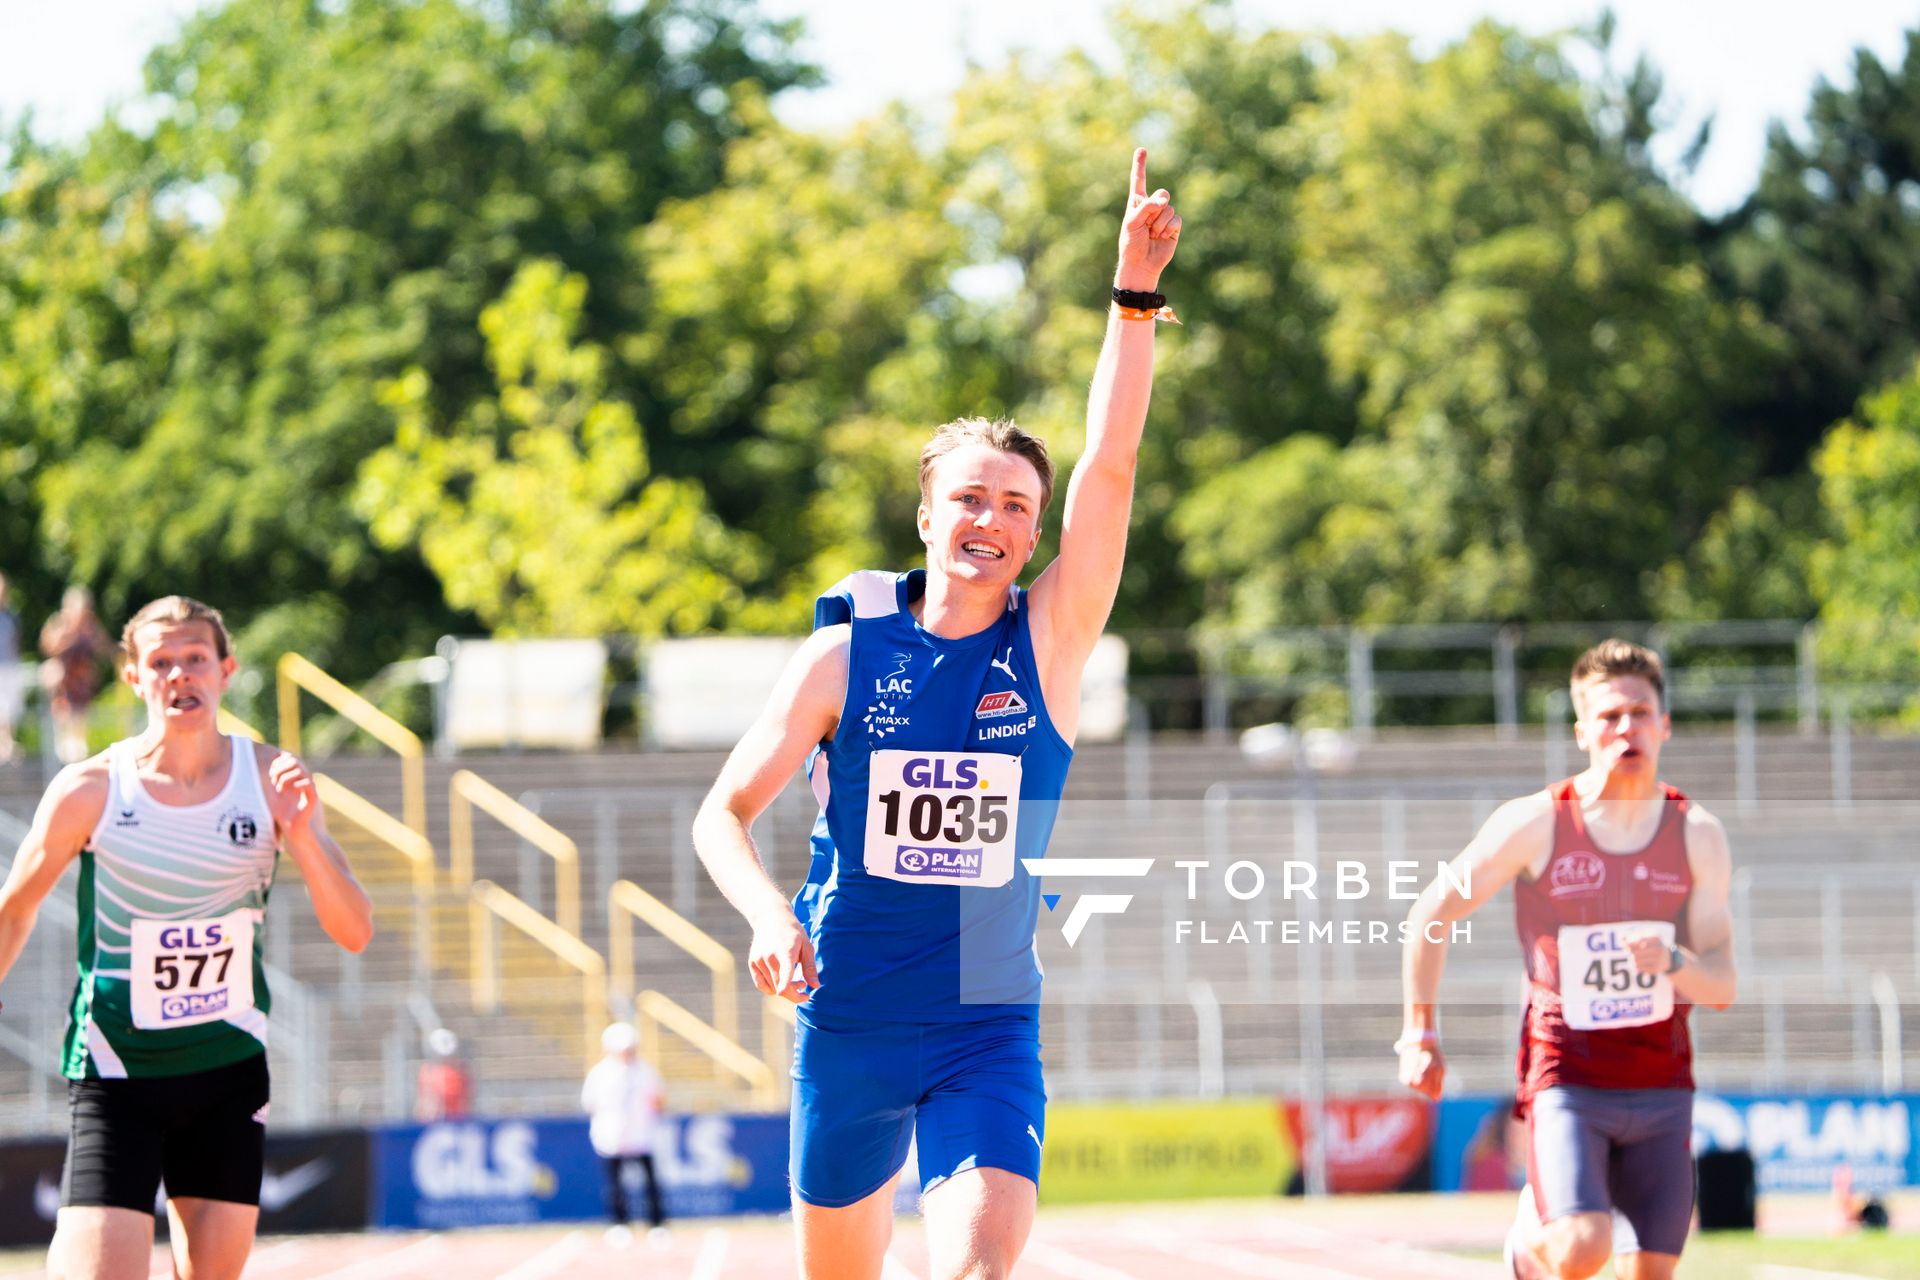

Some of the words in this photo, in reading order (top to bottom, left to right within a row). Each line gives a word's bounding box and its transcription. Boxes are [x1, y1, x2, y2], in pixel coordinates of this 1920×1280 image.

[875, 678, 913, 694] LAC
[984, 696, 1006, 708] HTI
[875, 715, 911, 725] MAXX
[978, 722, 1027, 741] LINDIG
[878, 789, 1008, 844] 1035
[931, 852, 979, 868] PLAN
[930, 867, 978, 875] INTERNATIONAL
[1586, 931, 1624, 952] GL
[154, 947, 235, 991] 577
